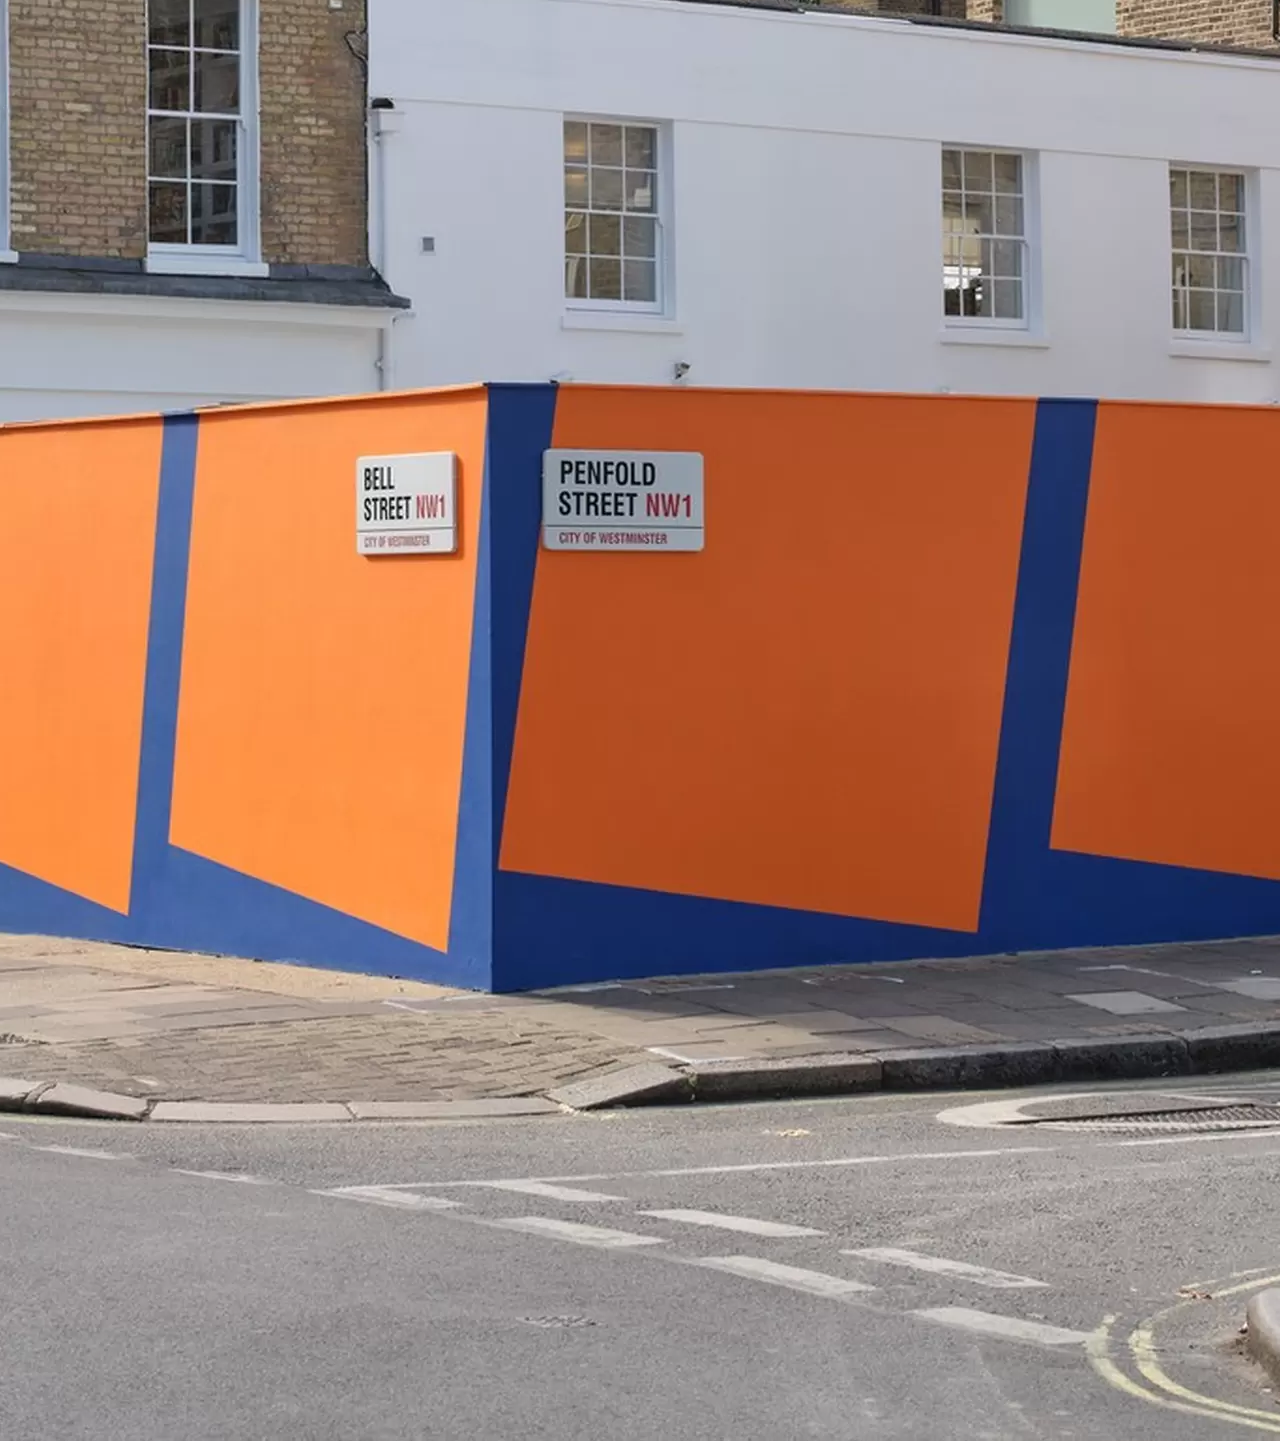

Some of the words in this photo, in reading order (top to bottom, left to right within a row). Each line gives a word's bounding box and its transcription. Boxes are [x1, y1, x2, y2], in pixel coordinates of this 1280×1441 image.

[363, 466, 395, 491] BELL
[560, 460, 656, 486] PENFOLD
[363, 496, 412, 521] STREET
[415, 494, 446, 519] NW1
[558, 491, 638, 517] STREET
[645, 492, 691, 518] NW1
[363, 536, 377, 548] CITY
[379, 535, 386, 548] OF
[388, 534, 431, 548] WESTMINSTER
[558, 531, 581, 544] CITY
[583, 531, 596, 544] OF
[599, 531, 668, 545] WESTMINSTER
